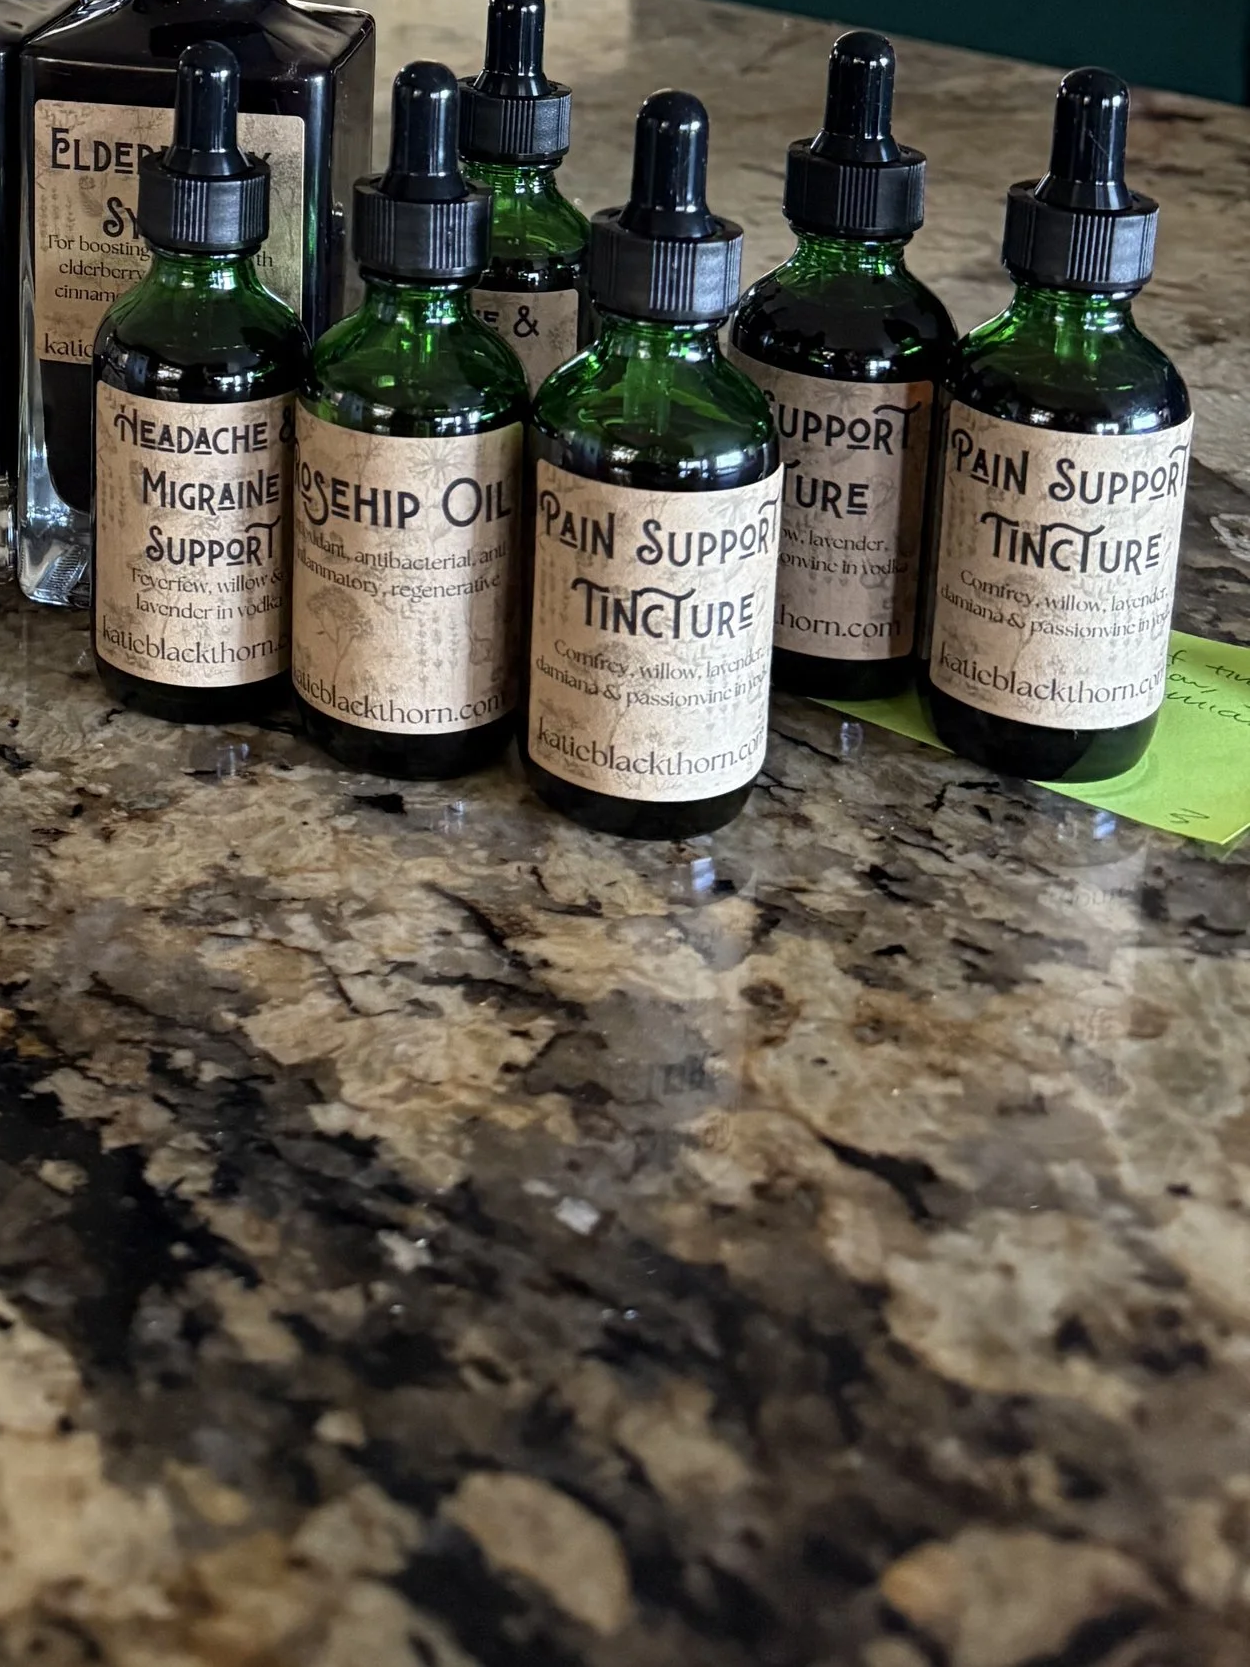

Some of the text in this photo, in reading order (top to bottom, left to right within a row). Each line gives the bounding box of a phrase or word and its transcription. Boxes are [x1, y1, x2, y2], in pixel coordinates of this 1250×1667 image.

[48, 234, 75, 251] For
[79, 235, 151, 262] boosting
[54, 285, 122, 303] cinnam
[513, 305, 540, 338] &
[114, 404, 268, 455] HEADACHE
[142, 467, 280, 516] MIGRAINE
[951, 428, 1190, 506] PAIN SUPPORT
[442, 477, 513, 528] OIL
[145, 515, 281, 568] SUPPORT
[539, 489, 779, 568] PAIN SUPPORT
[810, 530, 889, 552] lavender,
[980, 511, 1162, 575] TINCTURE
[131, 567, 213, 596] Feverfew,
[217, 573, 268, 594] willow
[391, 573, 501, 605] regenerative
[842, 560, 857, 574] in
[862, 557, 909, 575] vodka
[136, 592, 283, 620] lavender in vodka
[571, 577, 754, 640] TINCTURE
[940, 585, 1004, 623] damiana
[1006, 613, 1026, 630] &
[1030, 617, 1136, 638] passionvine
[1138, 617, 1149, 633] in
[960, 570, 1040, 609] Comfrey,
[1044, 594, 1107, 614] willow,
[536, 655, 599, 696] damiana
[602, 684, 622, 700] &
[626, 687, 732, 708] passionvine
[734, 681, 747, 697] in
[554, 639, 634, 679] Comfrey,
[638, 663, 703, 681] willow,
[294, 667, 506, 725] atieblackthorn.com
